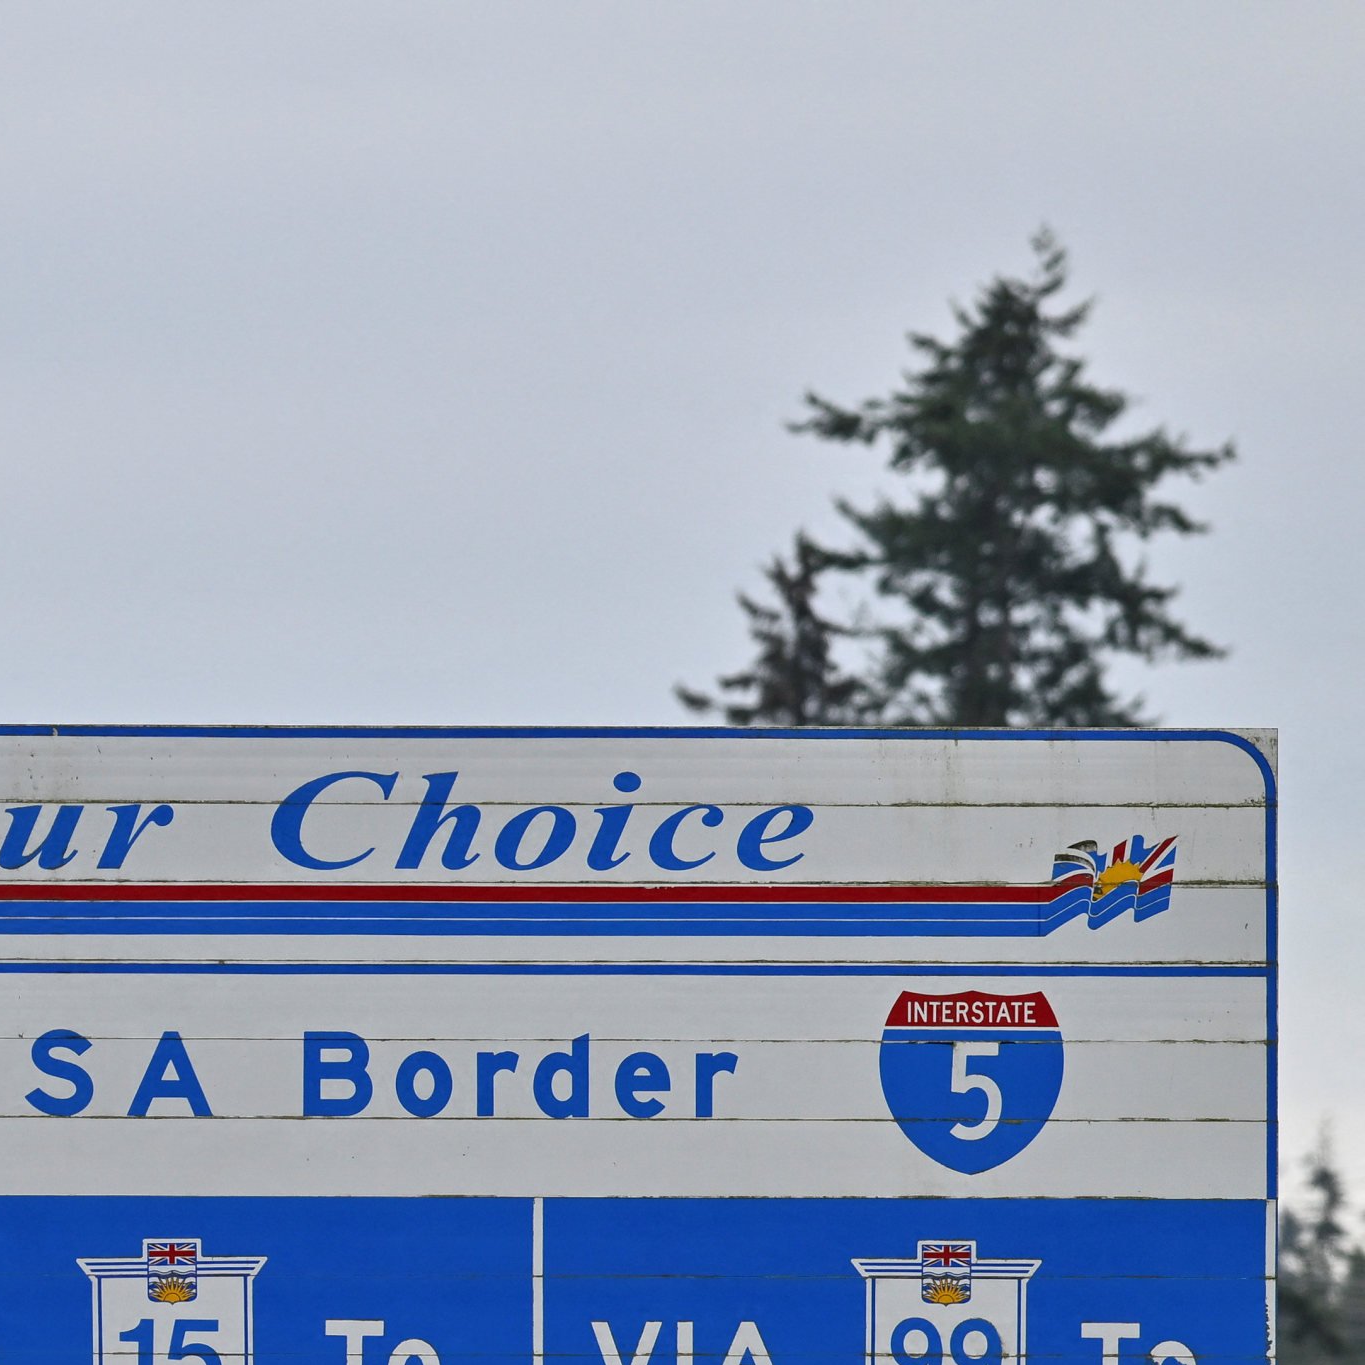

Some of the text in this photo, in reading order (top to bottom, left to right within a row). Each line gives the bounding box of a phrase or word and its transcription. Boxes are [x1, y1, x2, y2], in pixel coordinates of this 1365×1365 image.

[270, 770, 814, 872] Choice
[906, 1001, 1037, 1024] INTERSTATE
[303, 1030, 738, 1119] Border
[949, 1041, 1003, 1141] 5
